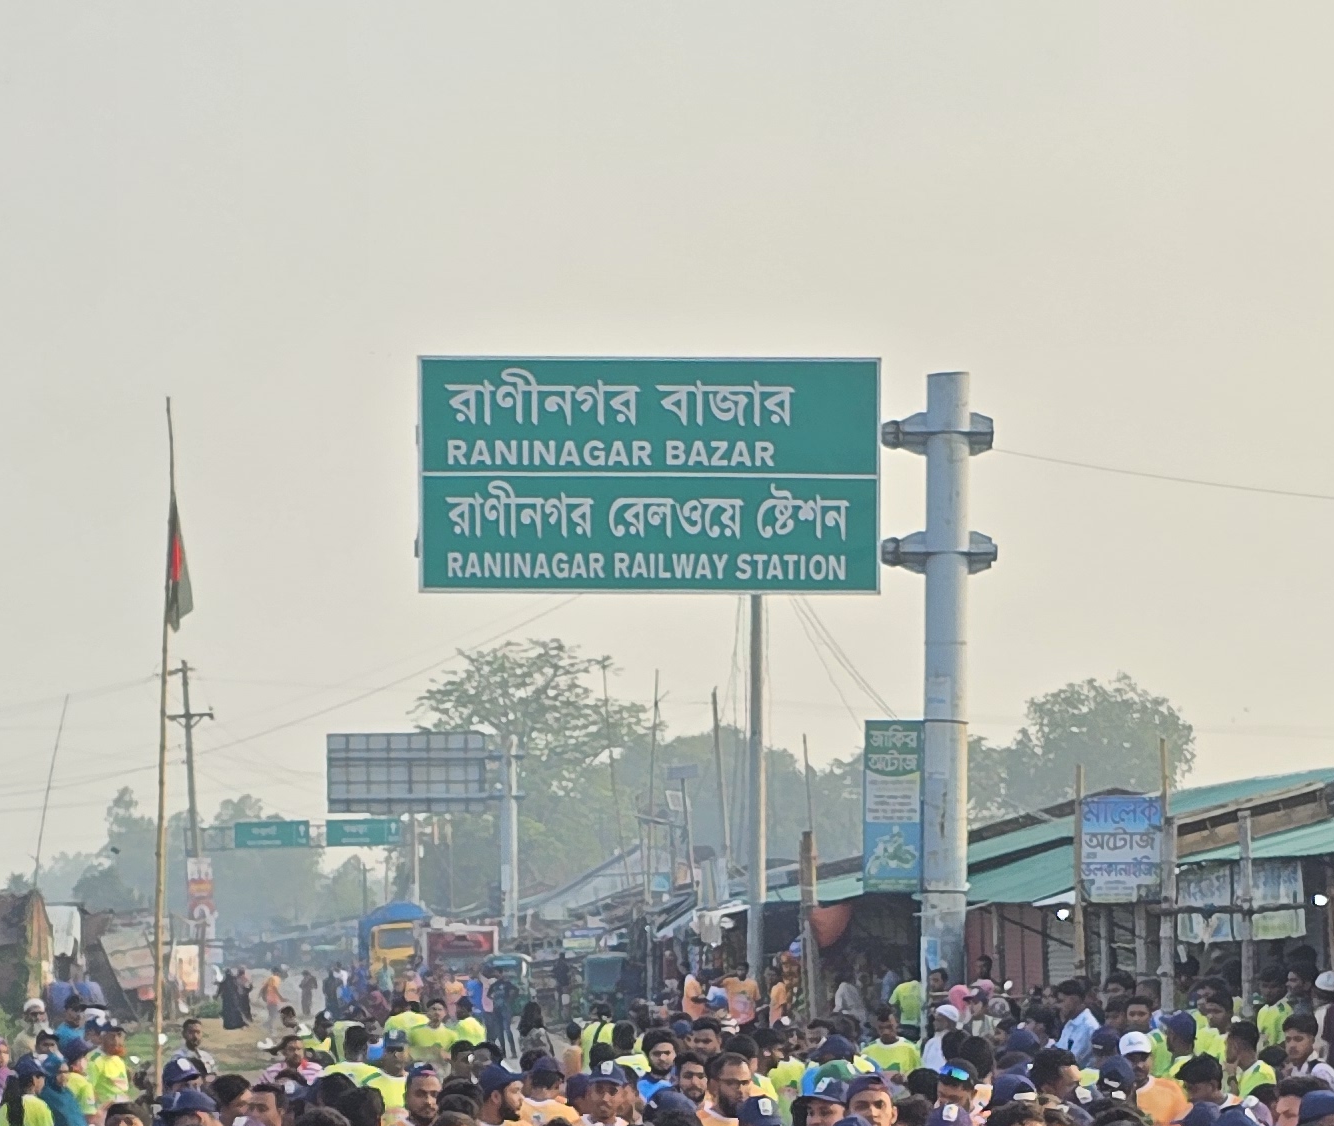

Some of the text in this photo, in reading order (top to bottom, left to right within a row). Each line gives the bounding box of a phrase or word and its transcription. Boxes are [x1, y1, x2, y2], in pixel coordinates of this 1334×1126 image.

[445, 368, 795, 427] রাণীনগর বাজার
[447, 440, 775, 467] RANINAGAR BAZAR
[446, 480, 593, 540] রাণীনগর
[609, 496, 744, 540] রেলওয়ে
[447, 552, 847, 581] RANINAGAR RAILWAY STATION
[1084, 827, 1156, 851] অটোজ
